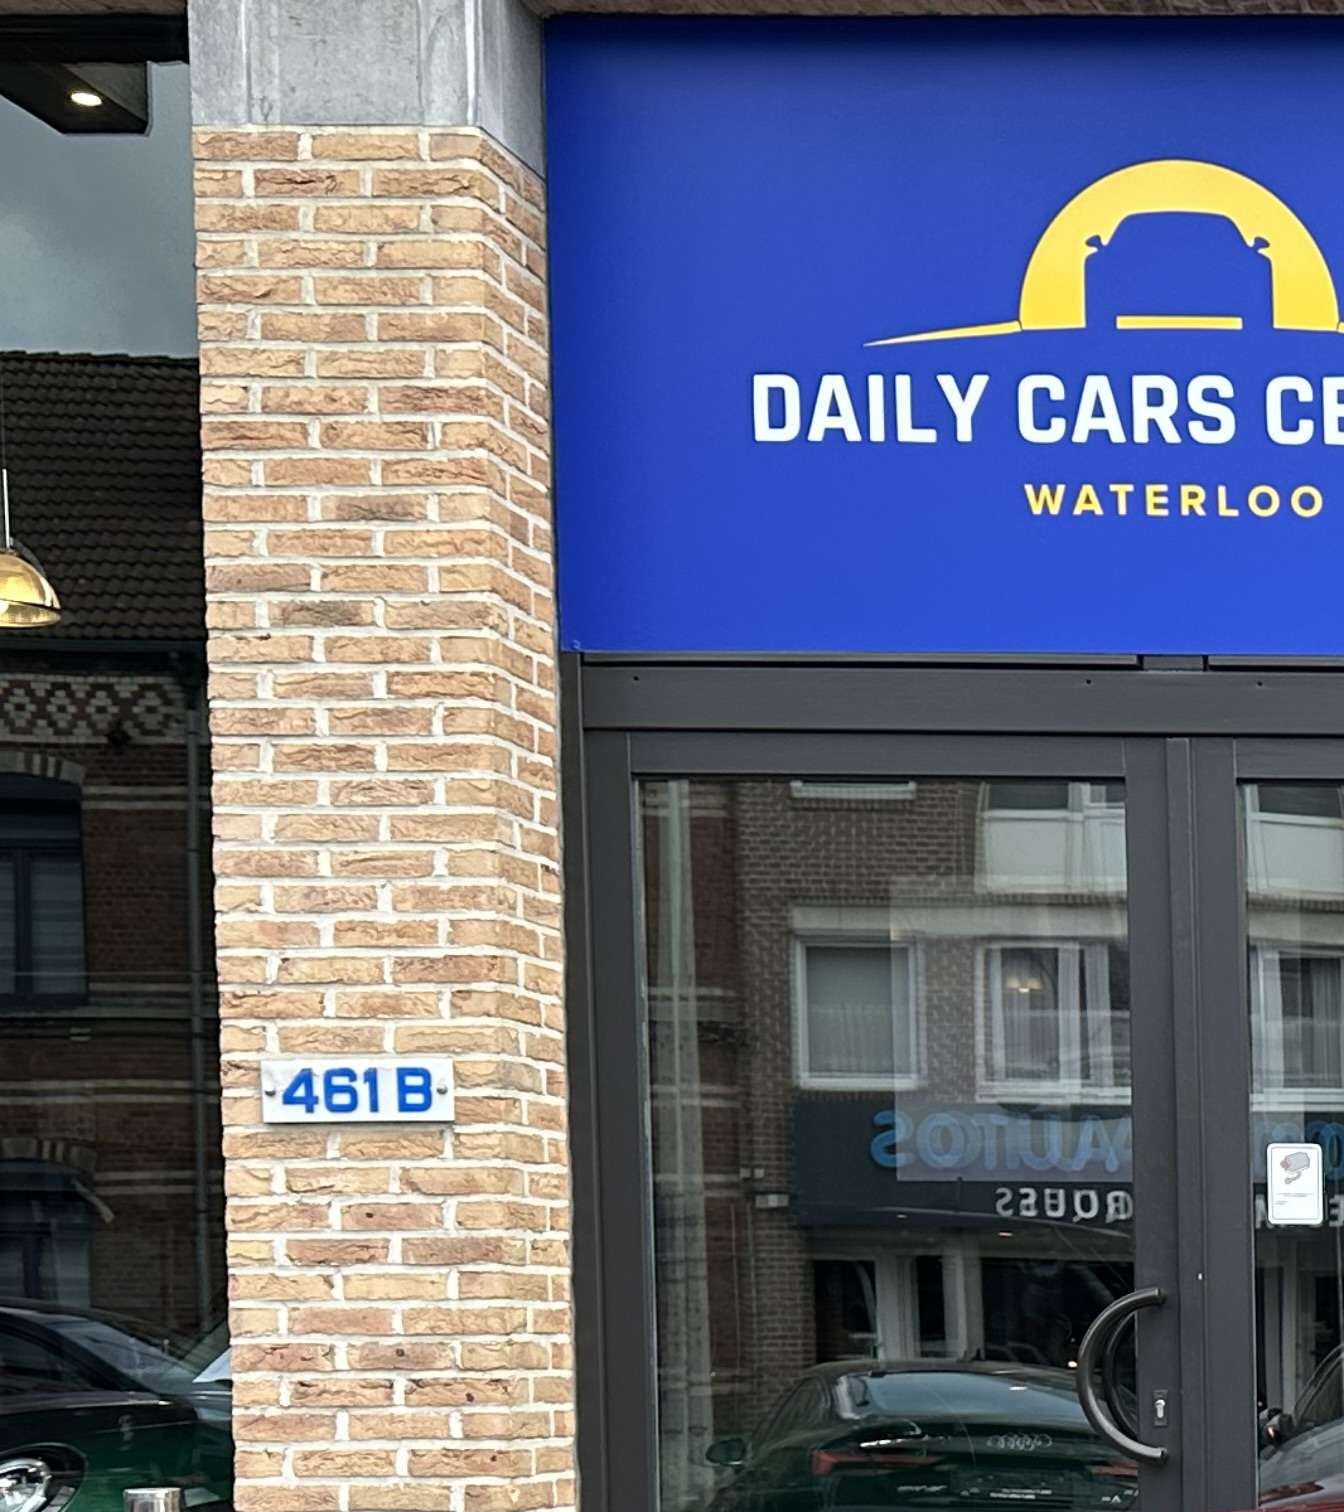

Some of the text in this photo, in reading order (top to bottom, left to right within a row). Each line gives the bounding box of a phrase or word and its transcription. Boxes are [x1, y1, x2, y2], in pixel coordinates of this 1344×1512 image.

[752, 373, 990, 443] DAILY
[1016, 373, 1238, 446] CARS
[1024, 483, 1326, 518] WATERLOO
[281, 1067, 433, 1113] 461 B
